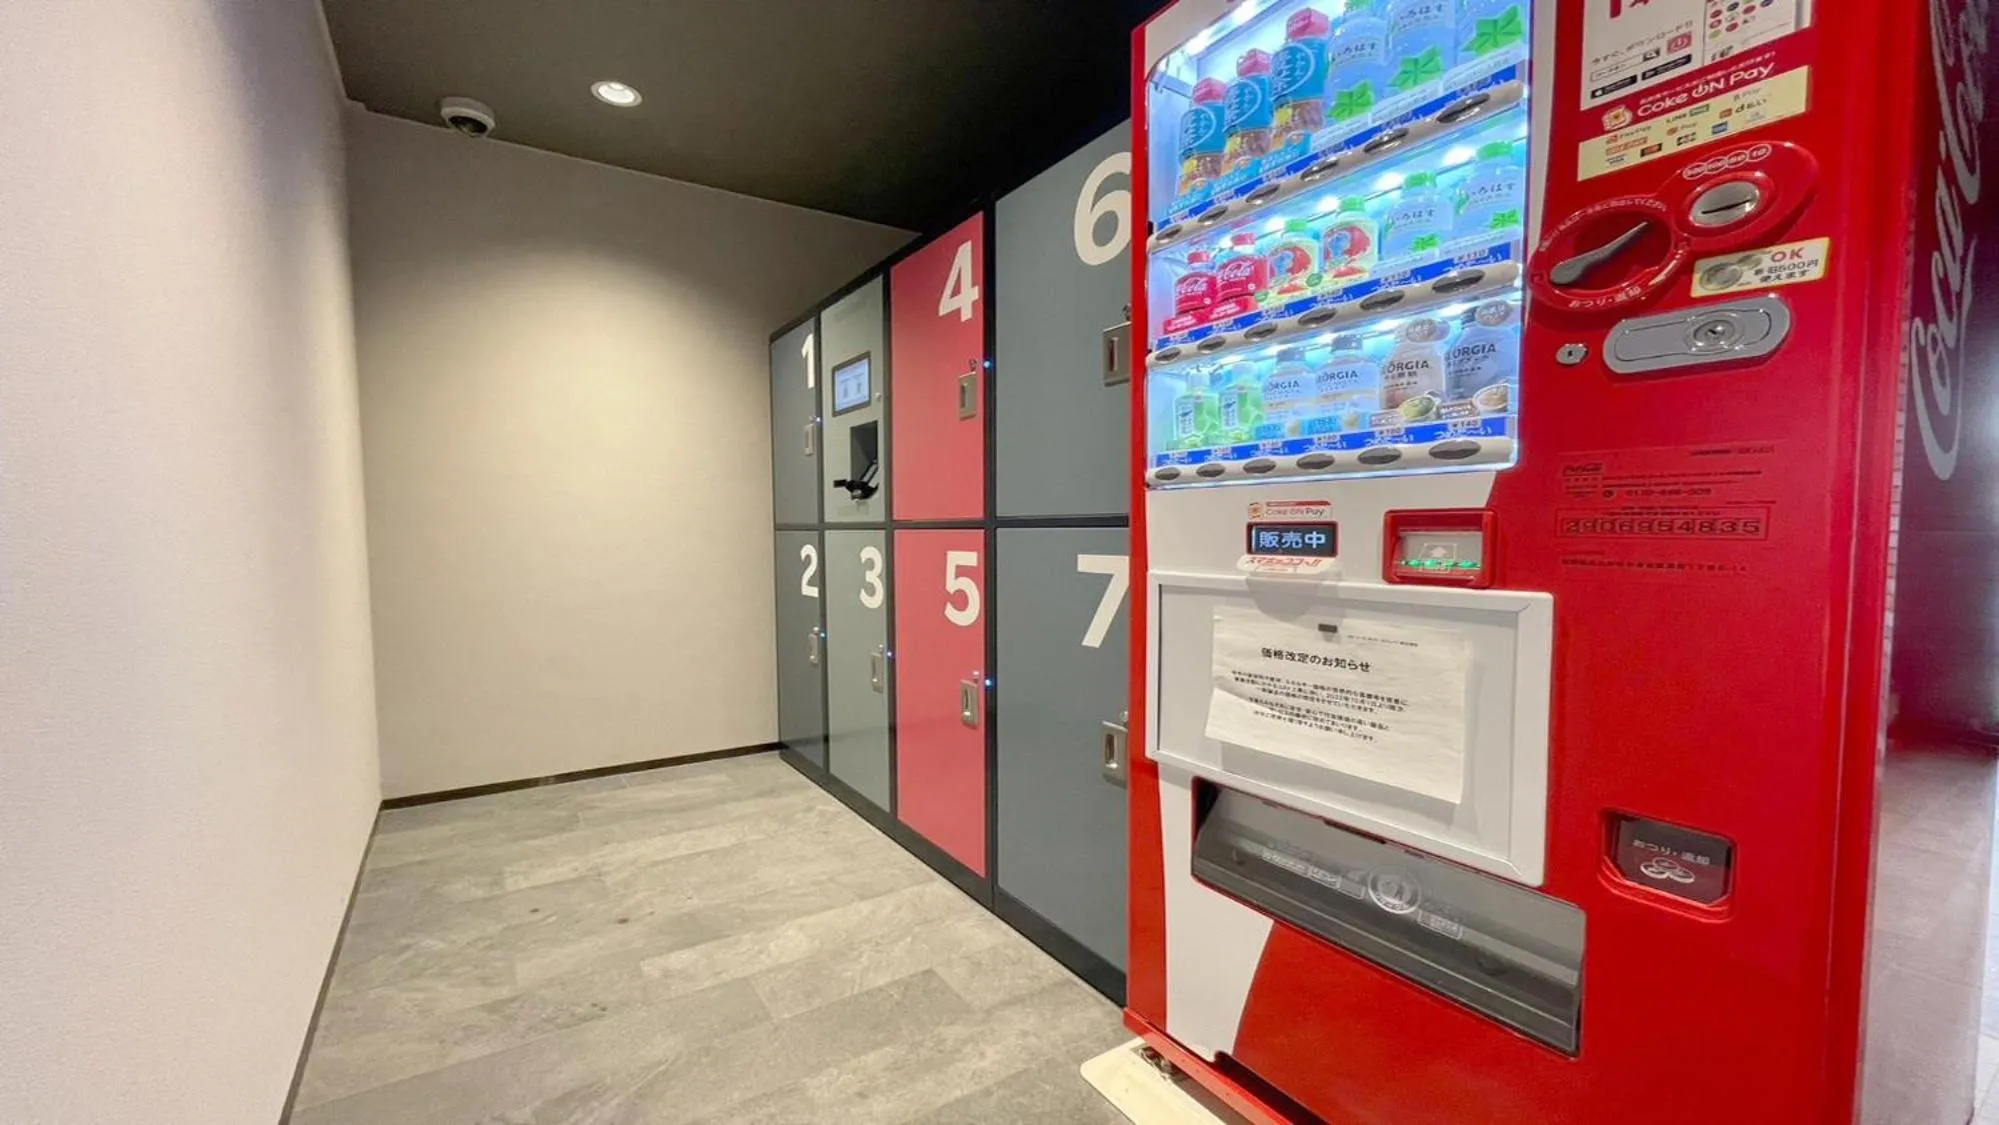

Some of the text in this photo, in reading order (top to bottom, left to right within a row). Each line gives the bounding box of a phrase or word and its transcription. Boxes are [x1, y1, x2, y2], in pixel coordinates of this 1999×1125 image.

[1636, 93, 1688, 117] Coke
[1729, 62, 1775, 86] Pay
[1074, 152, 1131, 266] 6
[938, 240, 979, 322] 4
[1771, 247, 1804, 262] OK
[801, 333, 815, 389] 1
[1259, 530, 1326, 549] 販売中
[1305, 508, 1326, 518] Pay
[800, 544, 820, 598] 2
[859, 545, 884, 609] 3
[944, 551, 980, 627] 5
[1076, 554, 1131, 649] 7
[1261, 647, 1371, 673] 価格改定のお知らせ
